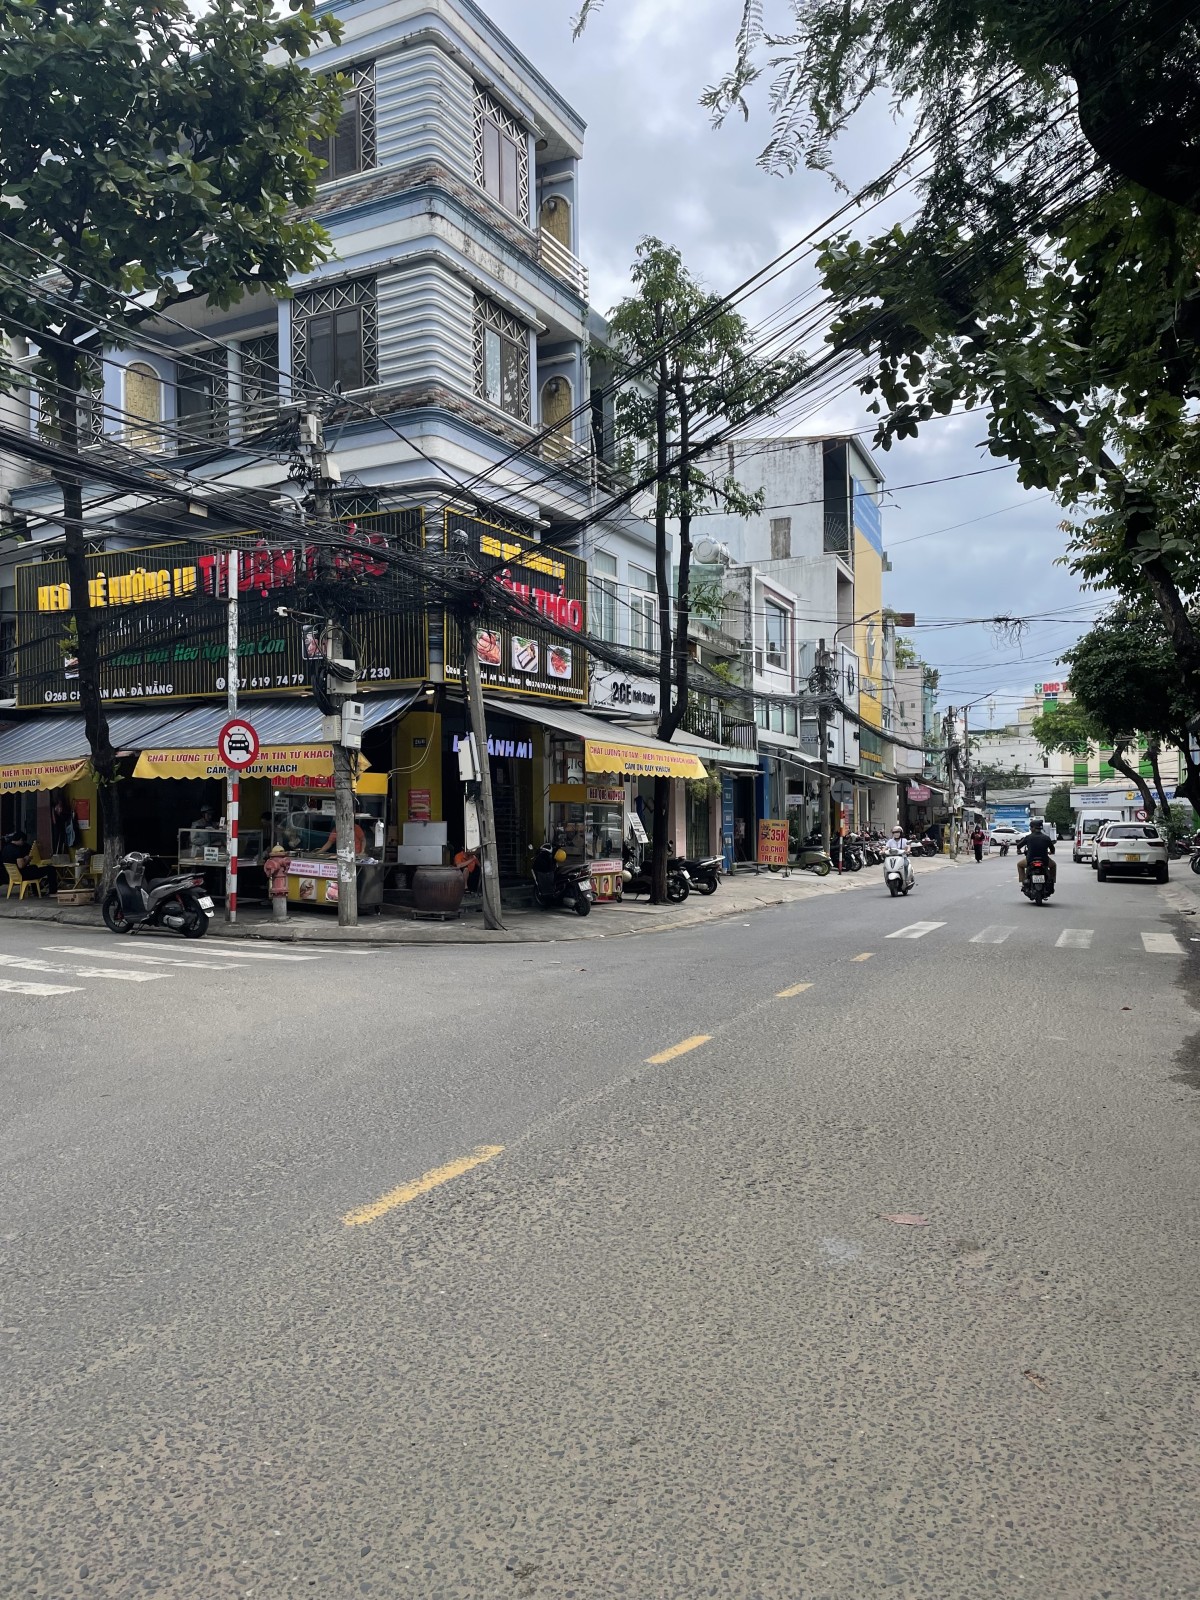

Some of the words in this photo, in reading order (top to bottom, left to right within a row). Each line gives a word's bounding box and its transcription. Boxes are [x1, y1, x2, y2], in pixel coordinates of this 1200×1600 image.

[38, 583, 71, 613] HEO
[108, 567, 171, 607] NƯỚNG
[173, 566, 197, 597] LU
[532, 584, 583, 633] THẢO
[173, 643, 199, 662] Heo
[258, 634, 286, 655] Con
[251, 677, 270, 687] 619
[276, 675, 289, 686] 74
[292, 674, 304, 684] 79
[370, 667, 390, 678] 230
[52, 692, 67, 702] 26B
[145, 681, 174, 695] NẴNG
[487, 734, 515, 757] ÁNH
[516, 738, 533, 759] MÌ
[147, 753, 169, 763] CHẤT
[171, 753, 200, 764] LƯỢNG
[204, 752, 215, 762] TỪ
[272, 752, 287, 760] TIN
[290, 750, 302, 759] TỪ
[22, 767, 33, 776] TIN
[44, 764, 69, 774] KHÁCH
[206, 764, 227, 774] CẢM
[245, 763, 264, 774] QUÝ
[266, 762, 298, 773] KHÁCH
[18, 778, 41, 788] KHÁCH
[770, 829, 786, 841] 35K
